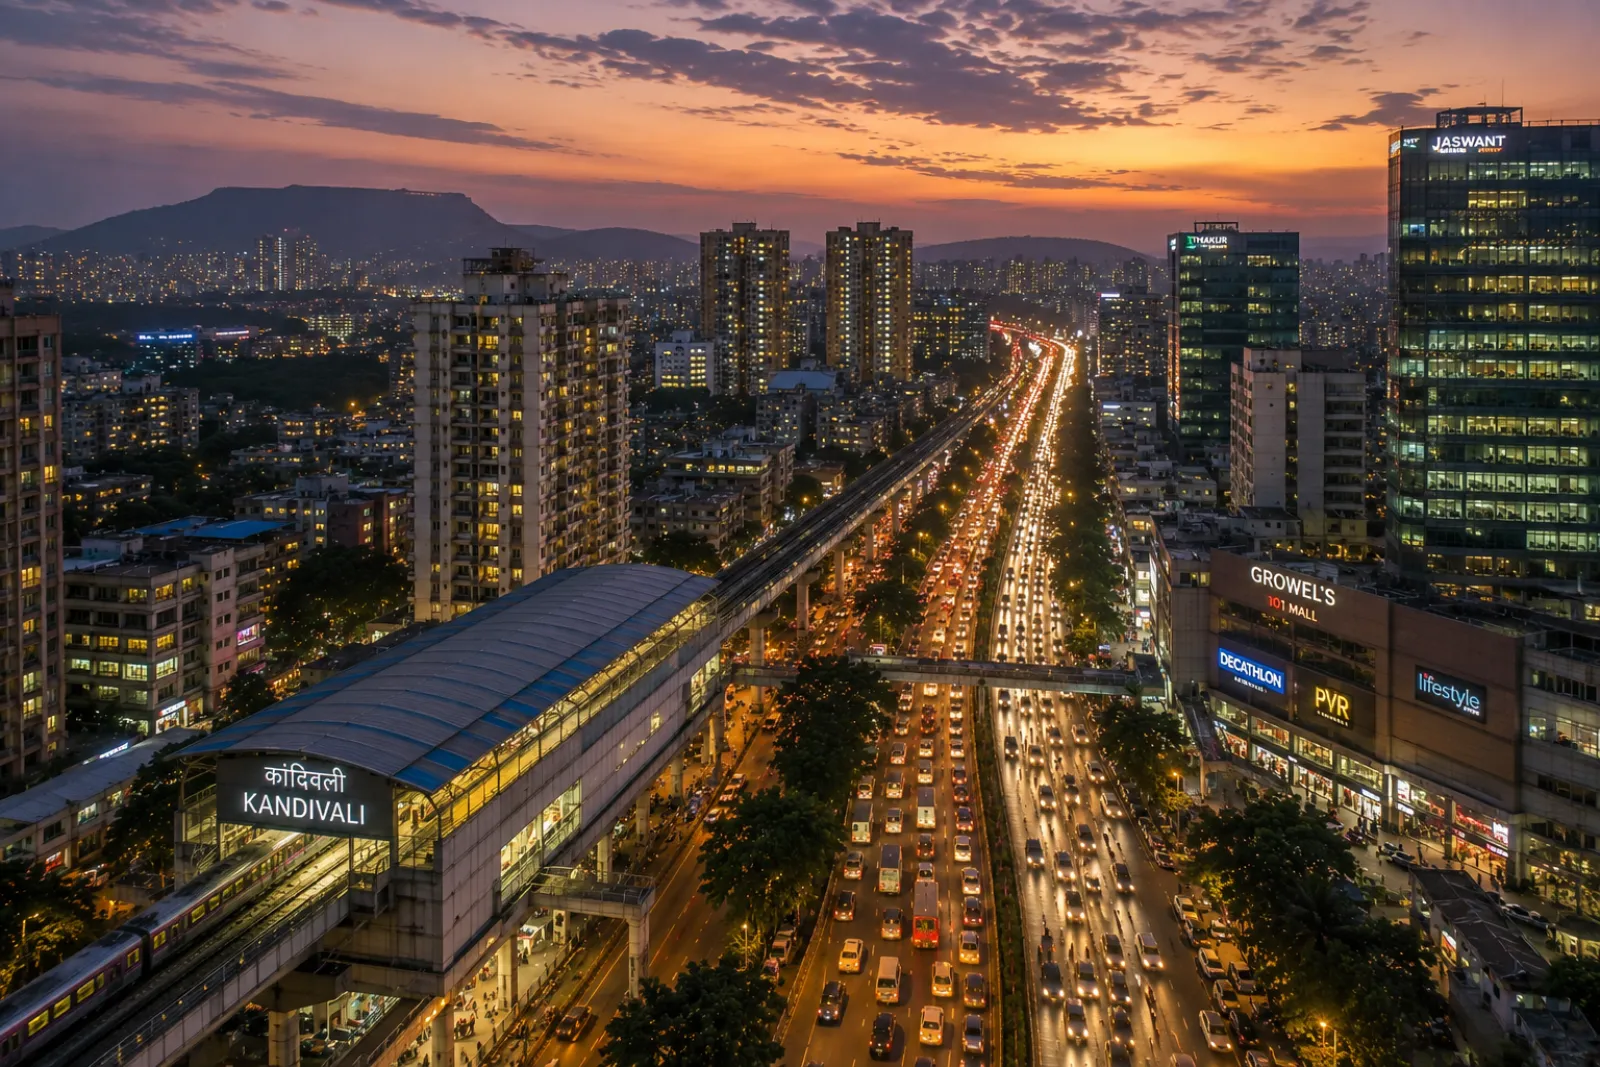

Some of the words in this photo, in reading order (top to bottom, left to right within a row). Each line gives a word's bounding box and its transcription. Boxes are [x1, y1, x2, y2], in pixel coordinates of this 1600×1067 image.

[1432, 135, 1506, 151] JASWANT
[1251, 566, 1336, 606] GROWEL'S
[1268, 595, 1286, 612] 101
[1289, 602, 1318, 622] MALL
[1220, 652, 1282, 689] DECATHLON
[1315, 686, 1350, 721] PVR
[1418, 672, 1480, 710] lifestyle
[264, 763, 346, 793] कांदिवली
[243, 791, 365, 825] KANDIVALI
